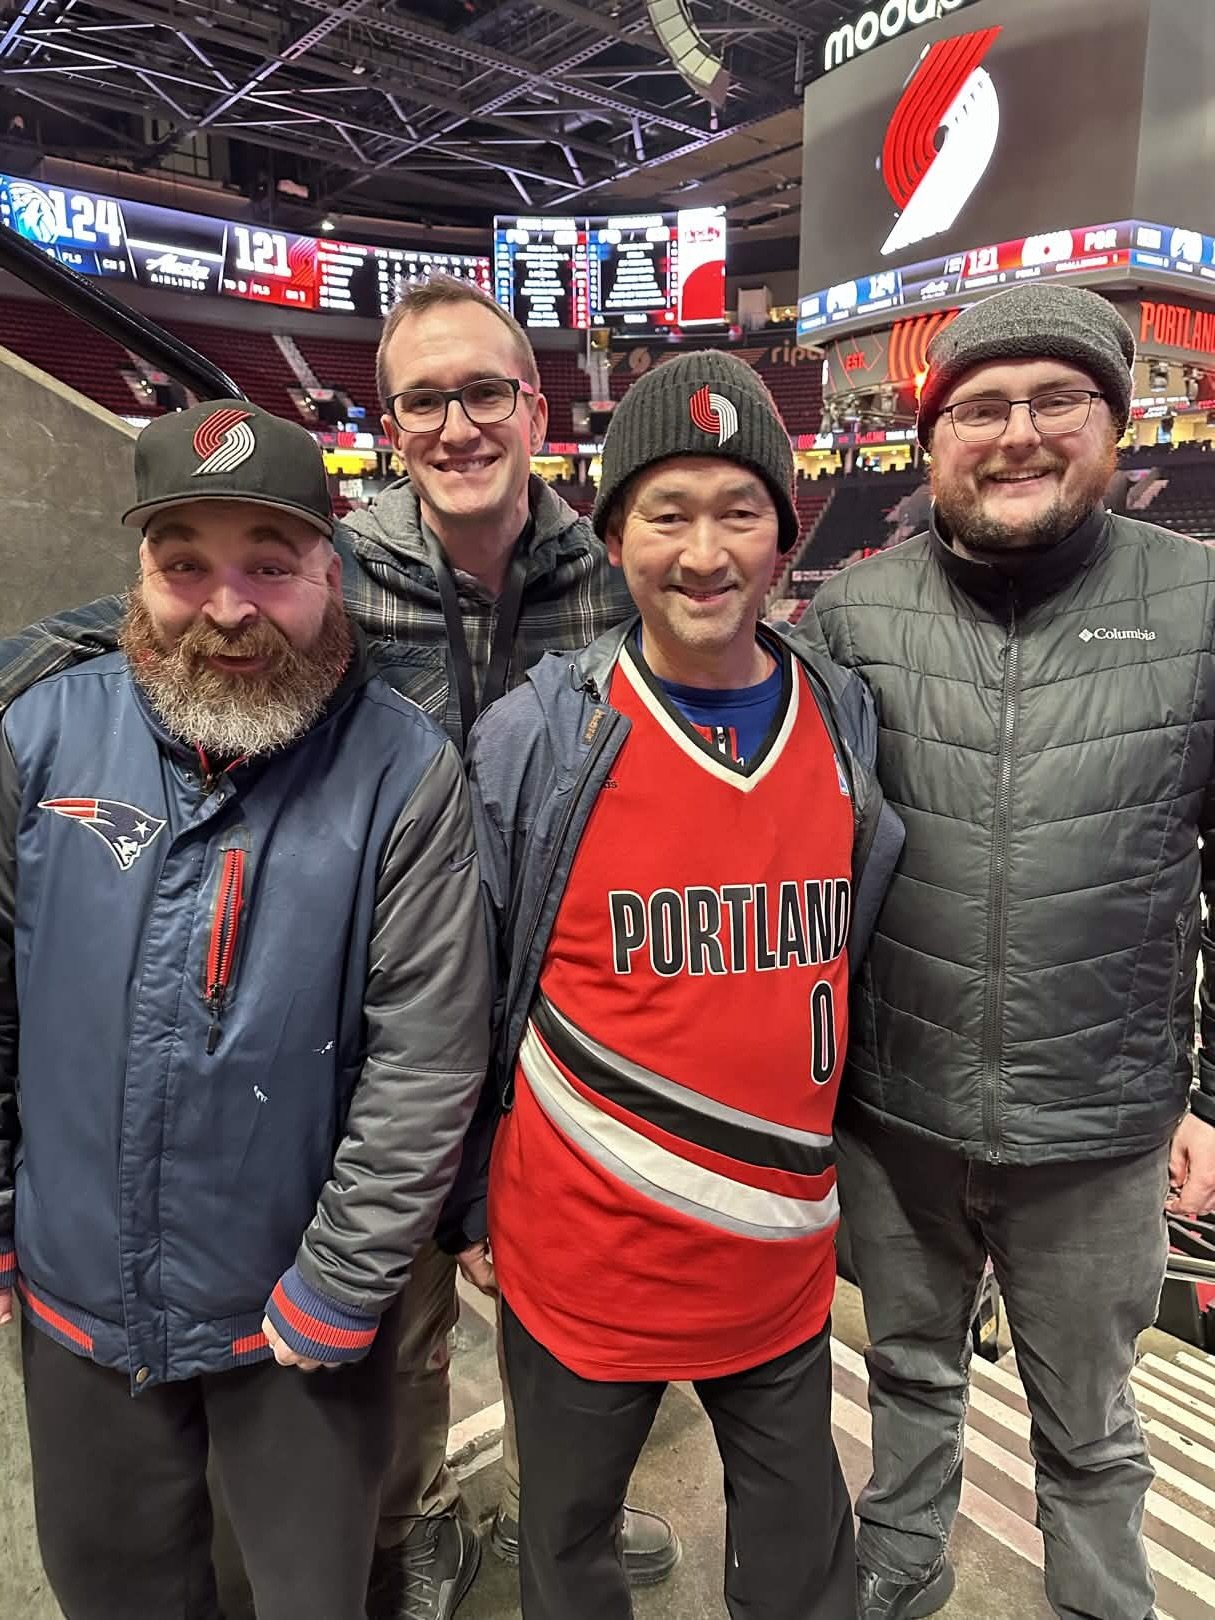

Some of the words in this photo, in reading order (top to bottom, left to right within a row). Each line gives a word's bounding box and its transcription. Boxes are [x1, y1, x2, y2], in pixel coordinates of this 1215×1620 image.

[48, 189, 121, 247] 124
[234, 226, 292, 277] 121
[967, 247, 999, 275] 121
[150, 273, 206, 291] AIRLINES
[1093, 627, 1156, 641] Columbia
[608, 879, 851, 978] PORTLAND
[810, 980, 837, 1086] 0
